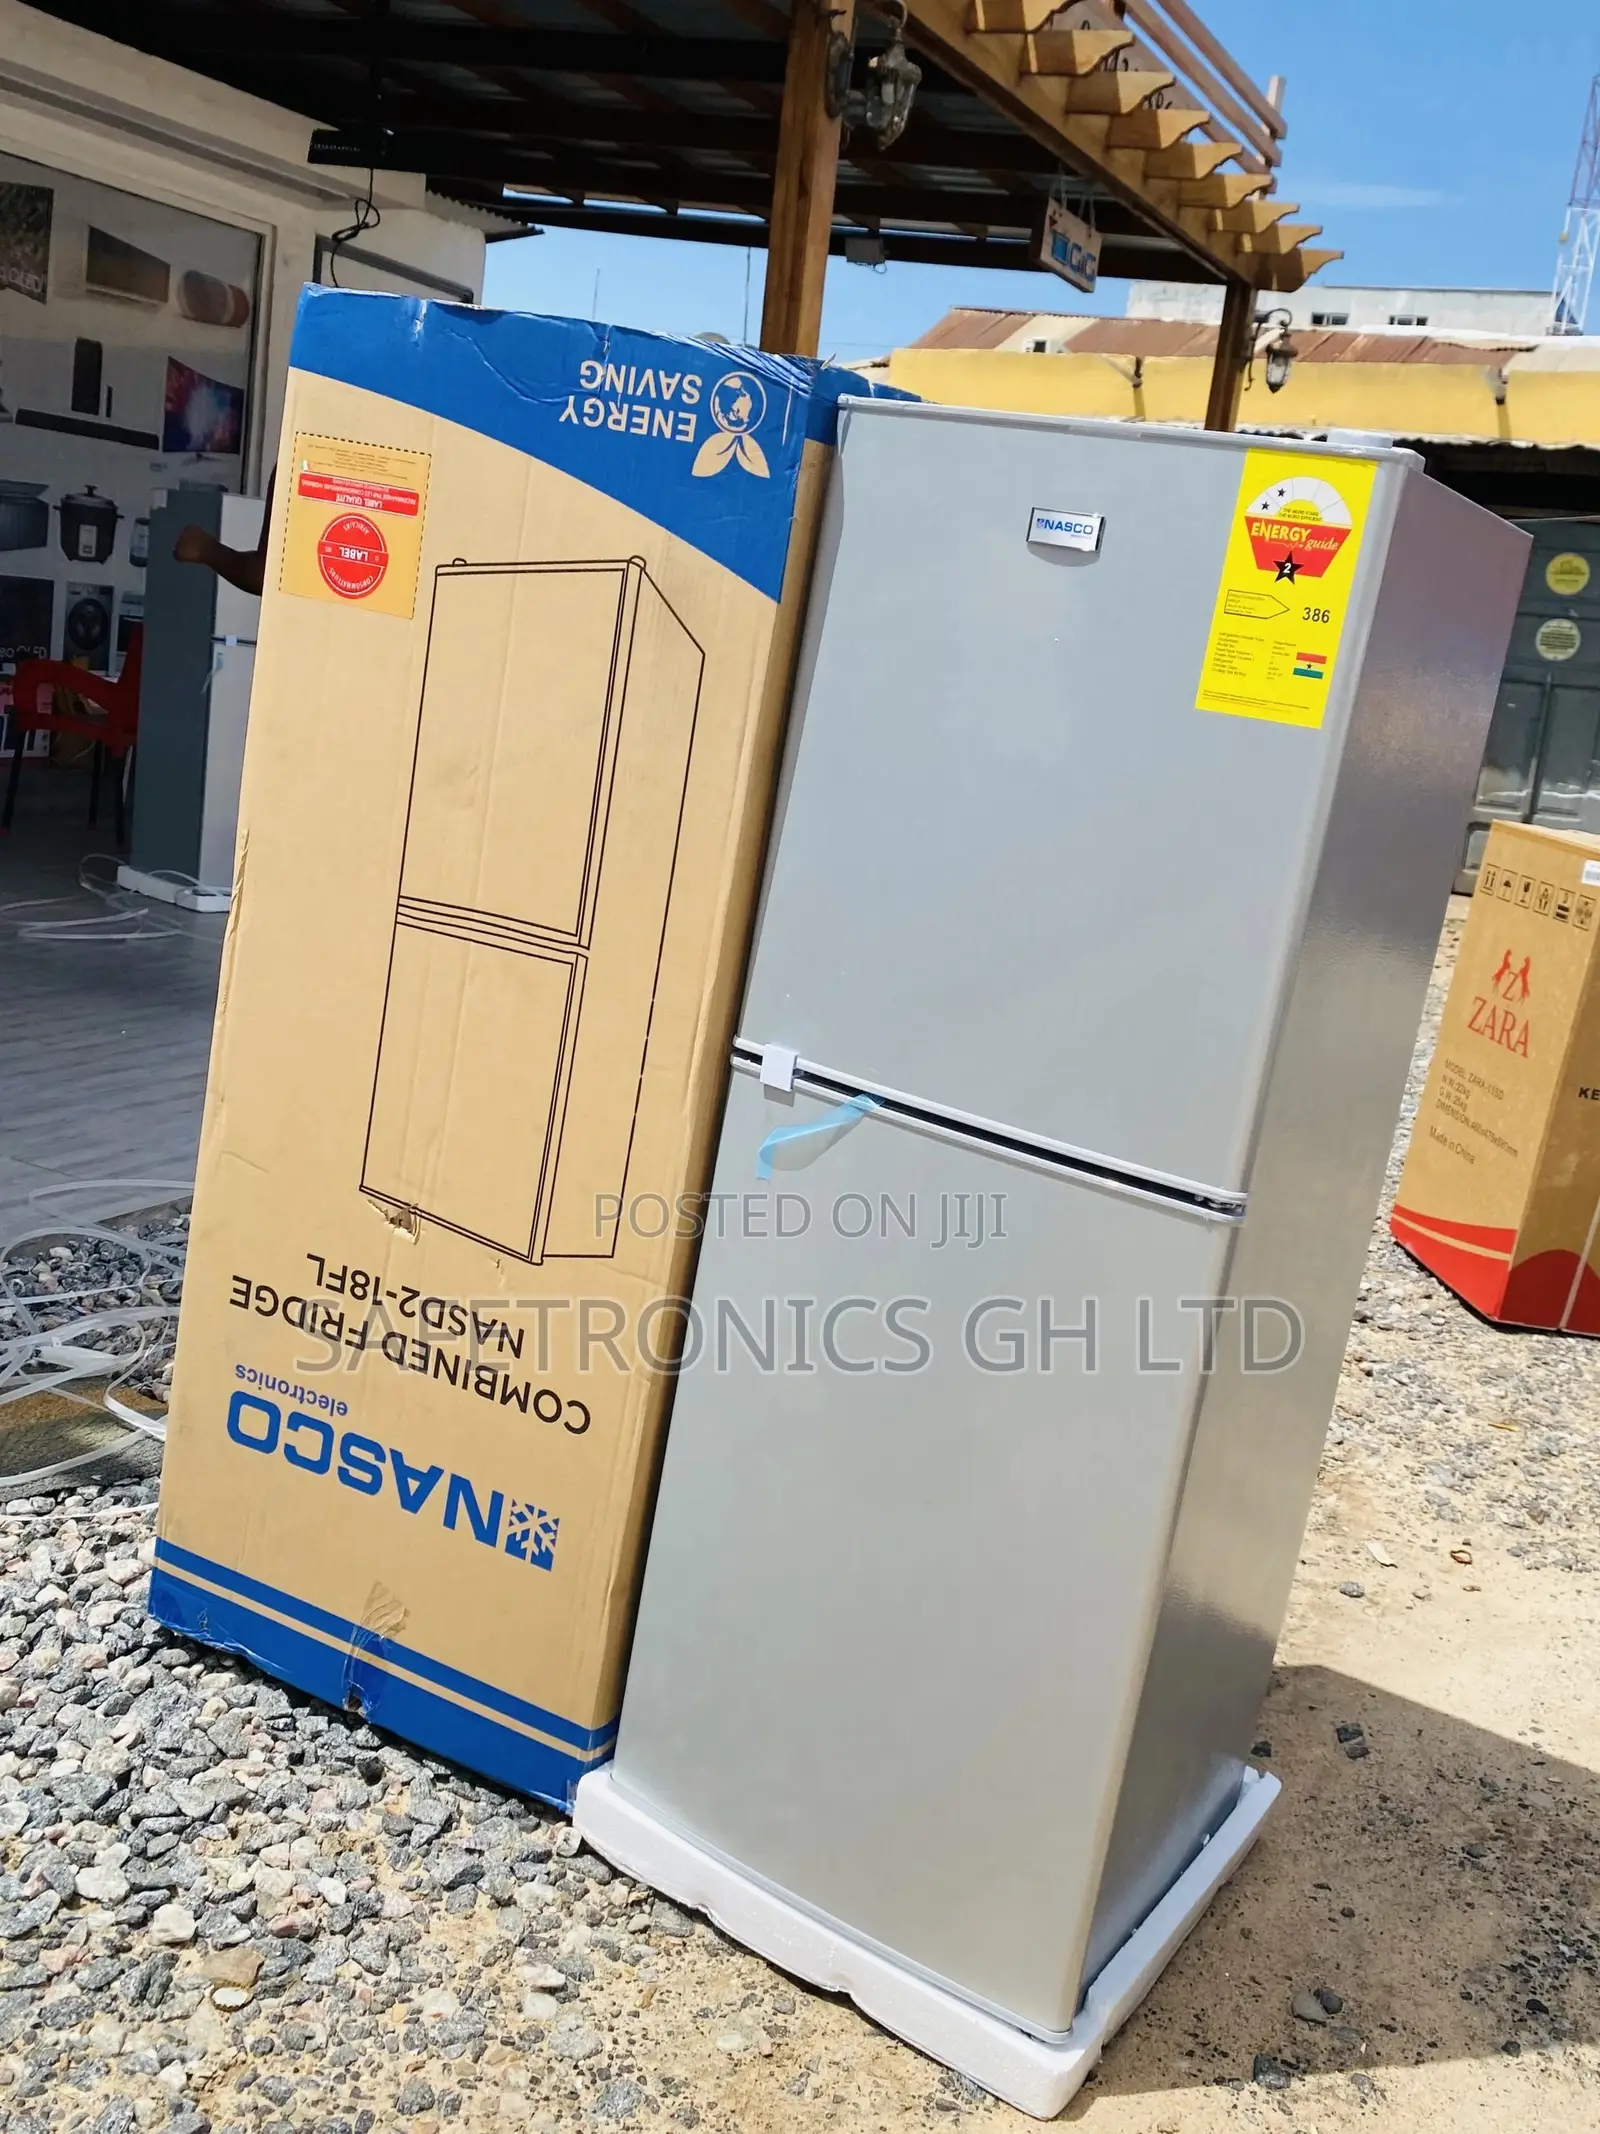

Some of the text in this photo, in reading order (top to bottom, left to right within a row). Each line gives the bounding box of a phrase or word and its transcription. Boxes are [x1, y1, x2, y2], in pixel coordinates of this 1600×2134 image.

[580, 360, 702, 404] SAVING
[559, 395, 697, 443] ENERGY
[1044, 519, 1094, 535] NASCO
[1251, 520, 1340, 551] ENERGY guide
[339, 546, 369, 562] LABEL
[1283, 563, 1291, 574] 2
[1302, 607, 1331, 623] 386
[1467, 996, 1529, 1058] ZARA
[1455, 1142, 1475, 1165] China
[306, 1252, 525, 1360] NASD2-18FL
[229, 1274, 591, 1435] COMBINED FRIDGE
[234, 1363, 348, 1417] electronics
[226, 1390, 504, 1548] NASCO
